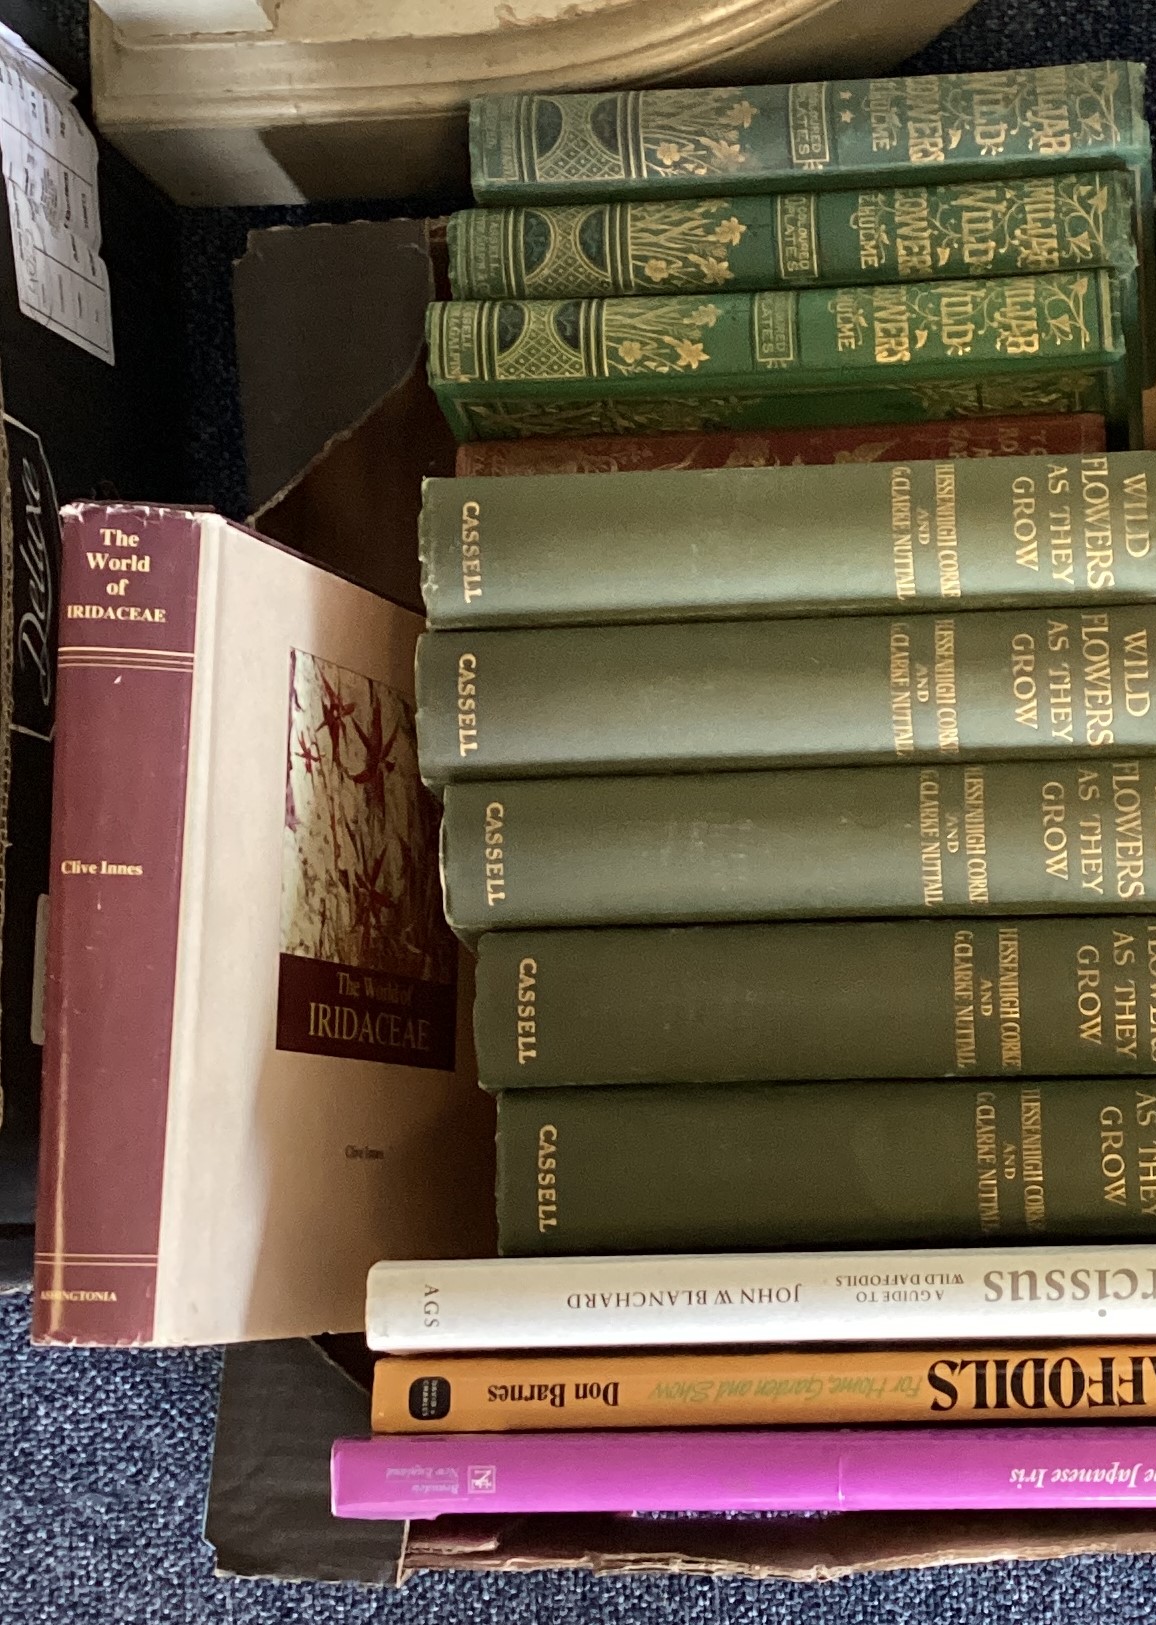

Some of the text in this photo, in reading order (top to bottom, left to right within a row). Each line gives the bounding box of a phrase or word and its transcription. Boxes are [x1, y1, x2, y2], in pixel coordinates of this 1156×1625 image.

[951, 186, 1006, 264] WILD
[100, 529, 139, 548] The
[918, 508, 930, 544] AND
[1012, 476, 1039, 571] GROW
[1047, 464, 1075, 585] AS THEY
[1081, 457, 1116, 590] FLOWERS
[1123, 473, 1150, 558] WILD
[86, 553, 150, 573] World
[461, 500, 483, 604] CASSELL
[894, 533, 916, 600] NUTTALL
[940, 550, 961, 598] CORKE
[18, 458, 52, 706] Deluxe
[106, 580, 128, 596] of
[67, 605, 166, 623] IRIDACEAE
[916, 664, 929, 702] AND
[1011, 633, 1038, 730] GROW
[1048, 620, 1074, 742] AS THEY
[1081, 613, 1114, 746] FLOWERS
[1122, 630, 1151, 717] WILD
[457, 653, 479, 757] CASSELL
[892, 690, 914, 757] NUTTALL
[937, 708, 960, 754] CORKE
[484, 801, 507, 907] CASSELL
[946, 813, 959, 853] AND
[1041, 782, 1069, 881] GROW
[1077, 769, 1104, 895] AS THEY
[1112, 763, 1145, 898] FLOWERS
[61, 861, 143, 876] Clive Innes
[921, 841, 944, 906] NUTTALL
[967, 858, 989, 904] CORKE
[337, 972, 359, 997] The
[515, 957, 538, 1065] CASSELL
[980, 979, 993, 1016] AND
[1076, 945, 1102, 1044] GROW
[1112, 930, 1138, 1059] AS THEY
[309, 1003, 431, 1050] IRIDACEAE
[955, 1004, 977, 1069] NUTTALL
[1001, 1022, 1022, 1070] CORKE
[537, 1124, 558, 1233] CASSELL
[1003, 1142, 1016, 1179] AND
[1100, 1106, 1127, 1207] GROW
[977, 1168, 1000, 1230] NUTTALL
[566, 1284, 802, 1310] JOHN W BLANCHARD
[836, 1274, 964, 1287] WILD DAFFODILS
[855, 1290, 945, 1303] A GUIDE TO
[487, 1382, 620, 1408] Don Barnes
[652, 1379, 714, 1401] Show
[717, 1379, 752, 1400] and
[756, 1377, 823, 1400] Garden
[890, 1377, 922, 1398] For
[1010, 1468, 1047, 1489] Iris
[1050, 1461, 1143, 1488] Japanese
